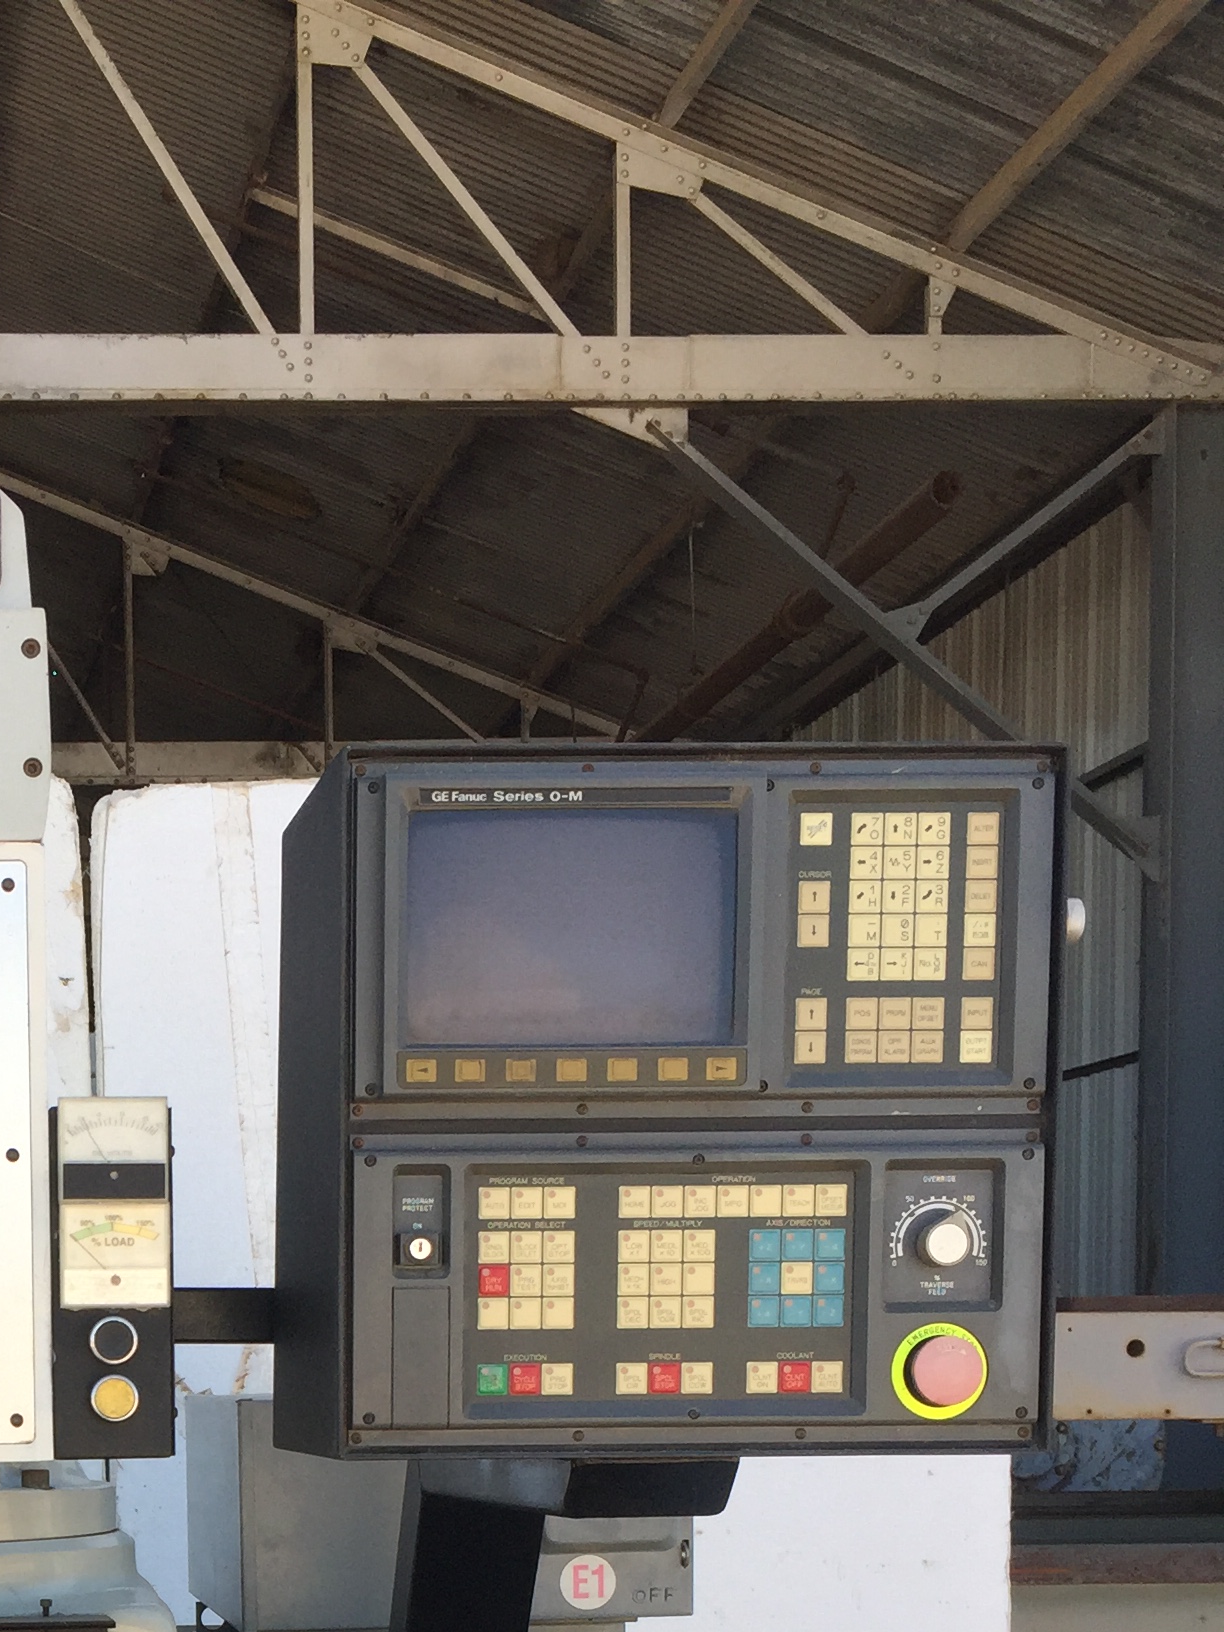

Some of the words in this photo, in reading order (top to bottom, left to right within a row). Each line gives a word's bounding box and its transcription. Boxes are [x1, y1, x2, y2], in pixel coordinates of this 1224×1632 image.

[431, 791, 450, 802] GE
[451, 791, 487, 802] Fanuc
[493, 790, 544, 802] Series
[871, 816, 880, 827] 7
[903, 816, 913, 827] 8
[937, 816, 946, 827] 9
[903, 829, 913, 840] N
[936, 829, 946, 840] G
[869, 851, 878, 861] 4
[902, 850, 912, 861] 5
[936, 850, 945, 861] 6
[869, 863, 878, 874] X
[902, 863, 912, 873] Y
[935, 863, 944, 874] Z
[798, 870, 832, 879] CURSOR
[869, 885, 875, 895] 1
[901, 884, 911, 895] 2
[935, 884, 944, 895] 3
[868, 897, 877, 907] H
[901, 897, 910, 907] F
[934, 897, 944, 907] R
[866, 931, 877, 941] M
[900, 931, 910, 941] S
[934, 930, 942, 941] T
[970, 960, 988, 968] CAN
[800, 987, 823, 996] PAGE
[853, 1009, 871, 1017] POS
[967, 1009, 988, 1017] INPUT
[488, 1177, 528, 1185] PROGRAM
[531, 1177, 565, 1185] SOURCE
[711, 1175, 756, 1183] OPERATION
[624, 1200, 645, 1208] HOME
[660, 1200, 677, 1208] JOG
[905, 1195, 915, 1203] 50
[518, 1201, 536, 1209] EDIT
[487, 1221, 532, 1229] OPERATION
[535, 1221, 567, 1229] SELECT
[91, 1237, 102, 1247] %
[104, 1237, 136, 1247] LOAD
[919, 1281, 955, 1289] TRAVERSE
[906, 1325, 956, 1346] EMERGENCY
[503, 1354, 548, 1362] EXECUTION
[648, 1352, 682, 1361] SPINDLE
[776, 1351, 815, 1360] COOLANT
[572, 1563, 606, 1600] E1
[631, 1586, 676, 1604] OFF
